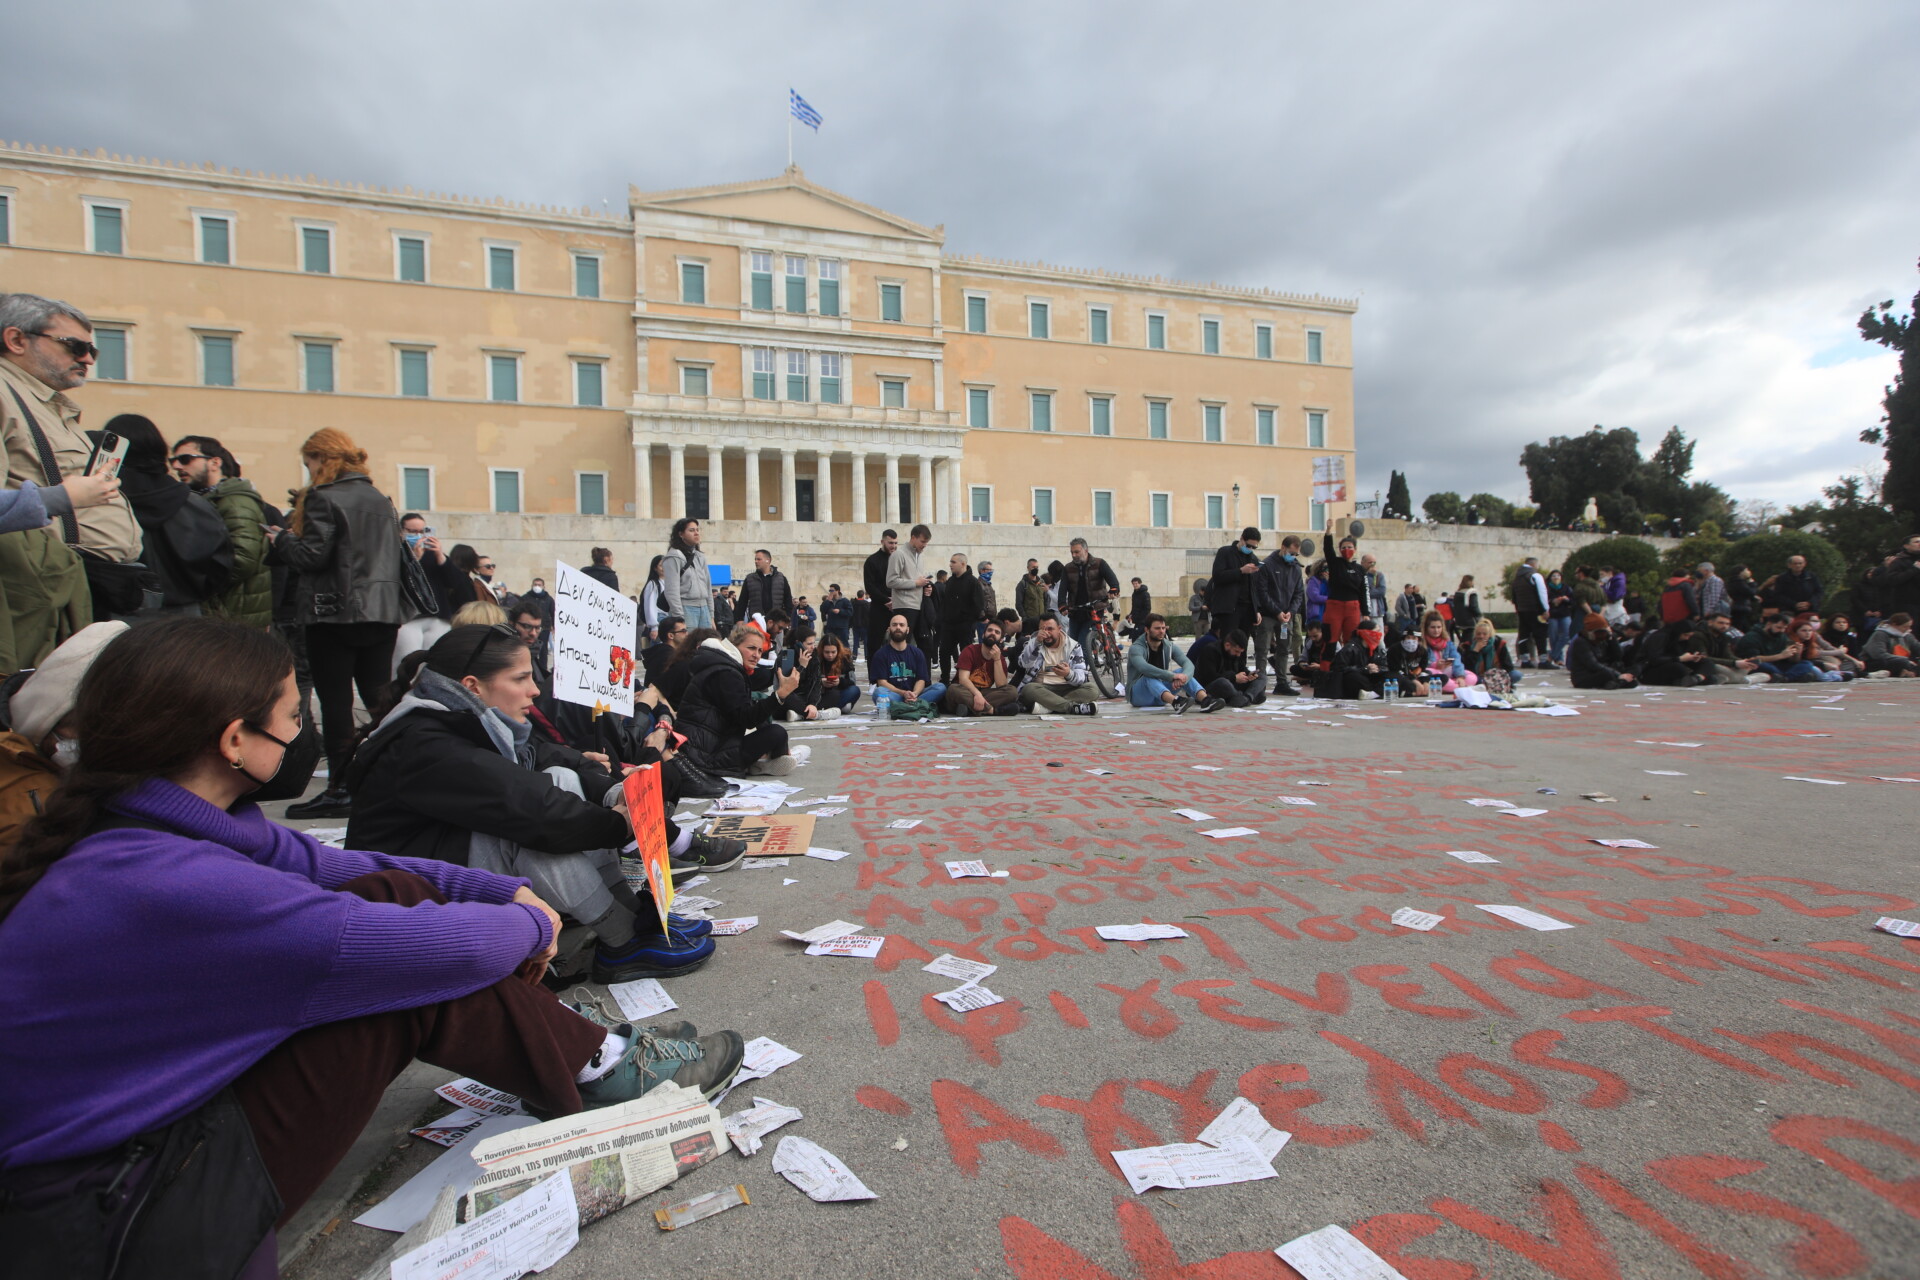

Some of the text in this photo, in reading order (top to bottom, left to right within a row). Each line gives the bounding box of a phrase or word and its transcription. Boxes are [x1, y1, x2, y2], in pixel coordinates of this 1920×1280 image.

[558, 570, 585, 601] Δεν
[608, 645, 636, 689] 57
[839, 775, 992, 791] Μαρία
[853, 875, 1320, 932] Αφροδίτη
[1702, 875, 1920, 918] 23
[440, 1085, 494, 1111] ΣΚΟΤΩΝΕΙ
[462, 1083, 492, 1097] ΒΡΕΙ
[526, 1160, 541, 1172] της
[597, 1140, 611, 1153] της
[612, 1129, 655, 1149] κυβέρνησης
[655, 1125, 668, 1137] των
[509, 1208, 538, 1229] ΕΓΚΛΗΜΑ
[539, 1204, 548, 1212] ΤΟ
[471, 1234, 488, 1249] ΕΧΕΙ
[489, 1224, 508, 1240] ΑΥΤΟ
[436, 1243, 469, 1268] ΙΣΤΟΡΙΑ!
